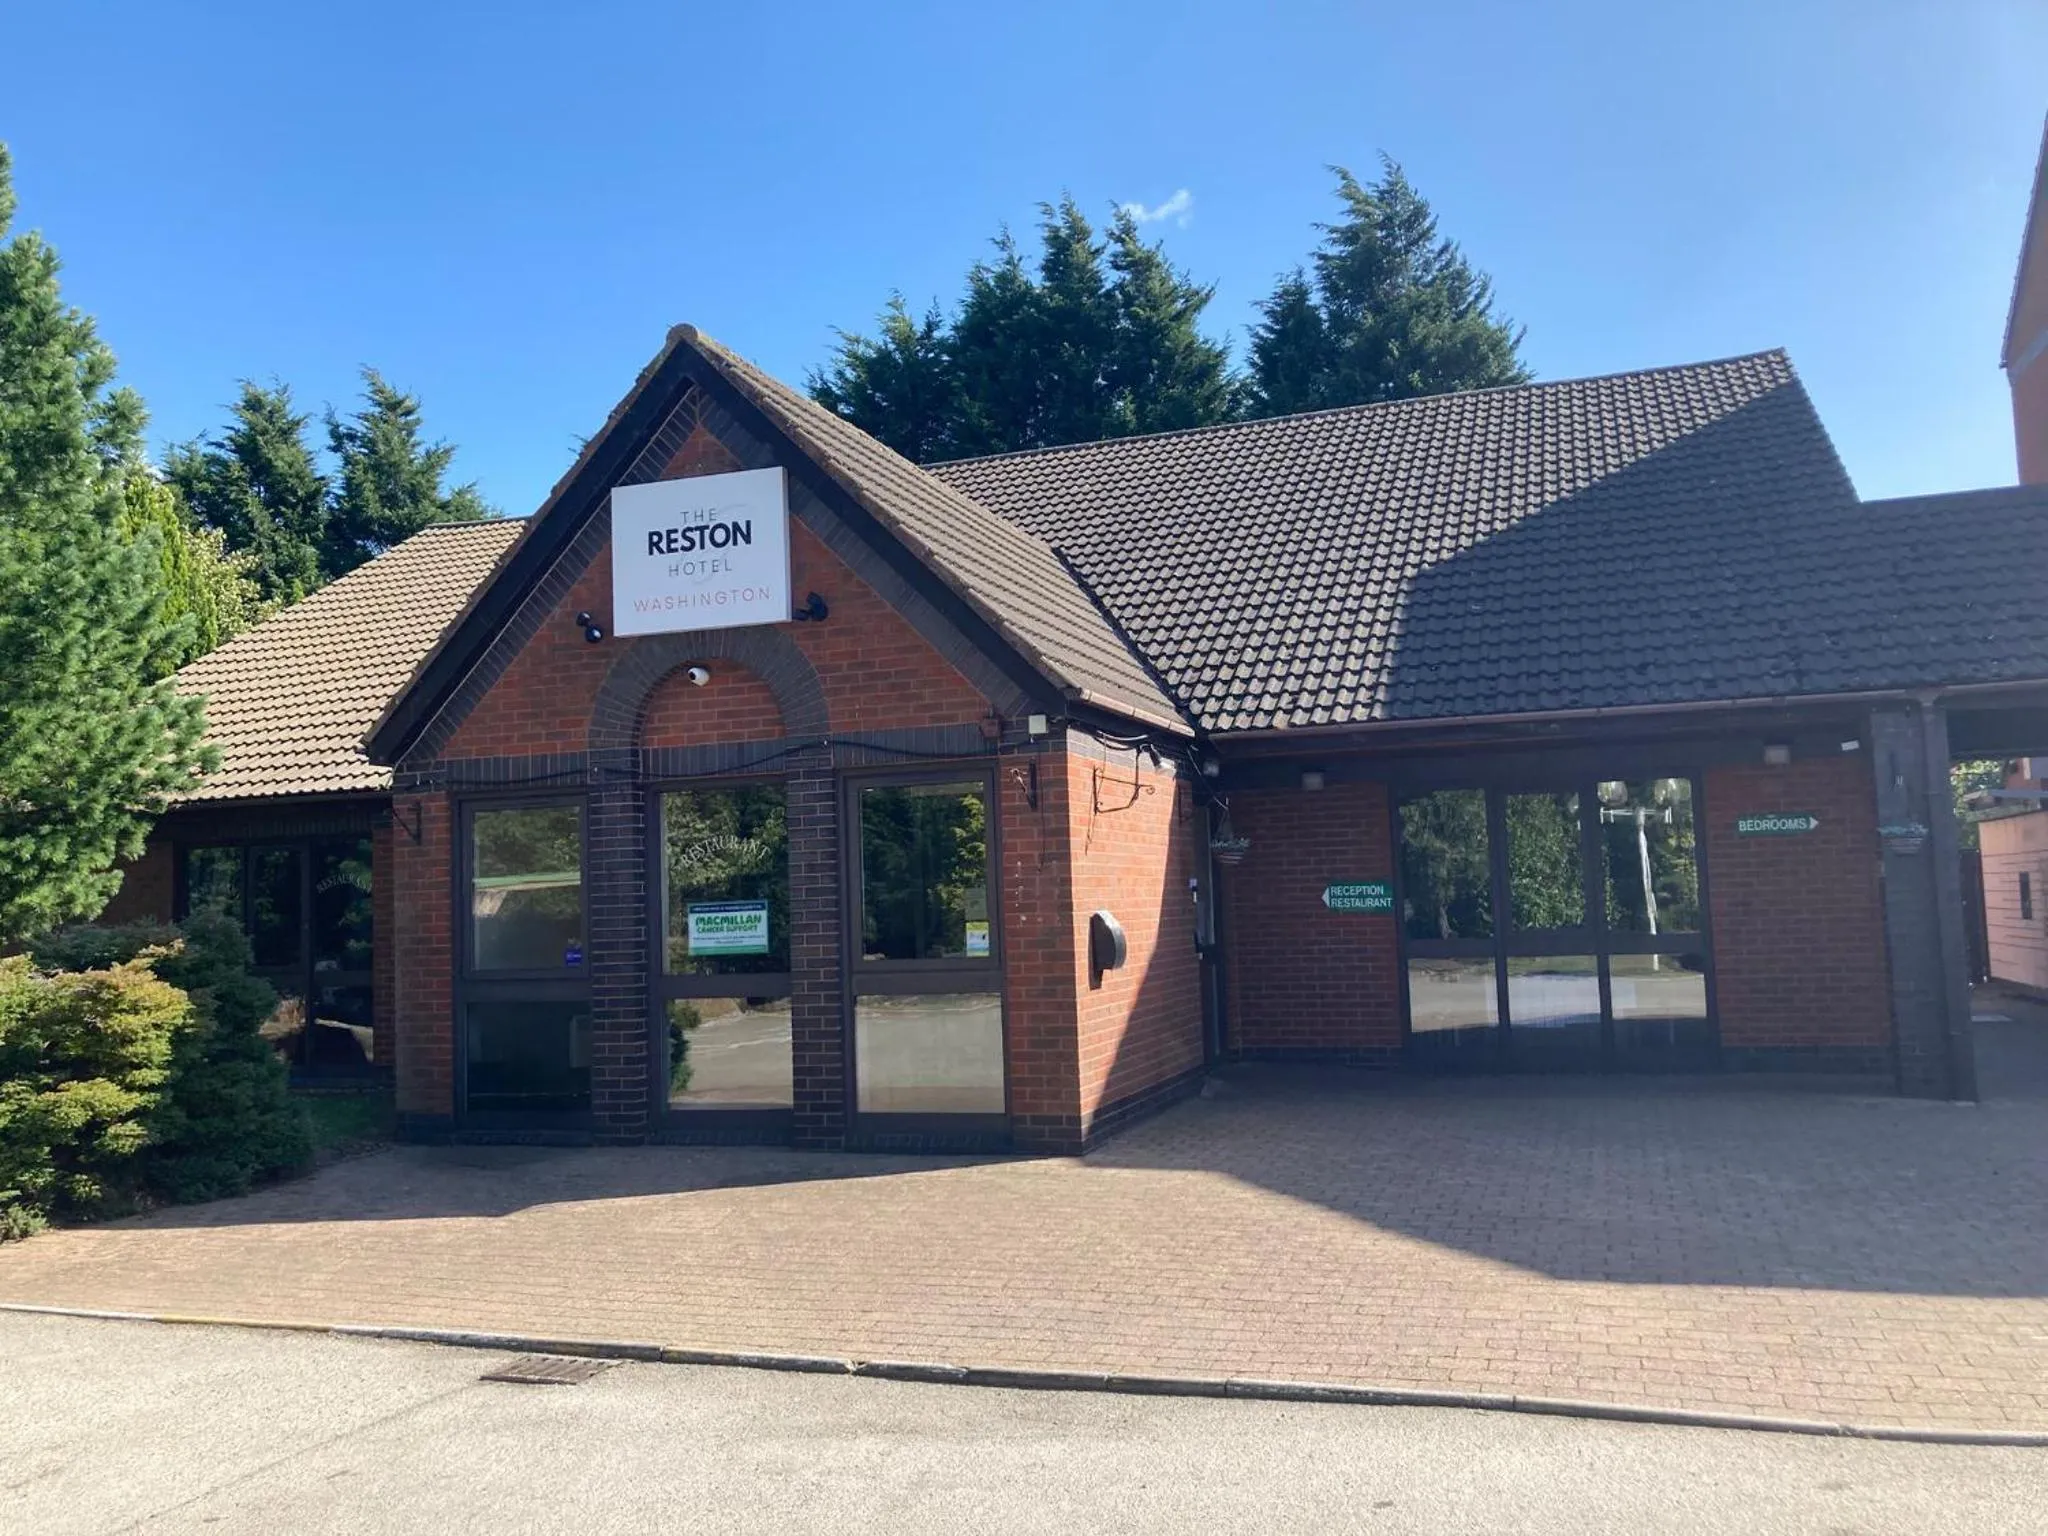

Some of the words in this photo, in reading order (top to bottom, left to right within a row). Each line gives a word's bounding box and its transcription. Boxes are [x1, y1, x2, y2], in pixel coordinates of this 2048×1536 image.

[680, 508, 718, 524] THE
[648, 520, 752, 556] RESTON
[668, 559, 733, 577] HOTEL
[633, 586, 771, 613] WASHINGTON
[1738, 818, 1807, 831] BEDROOMS
[681, 834, 772, 868] RESTAURANT
[1330, 884, 1384, 897] RECEPTION
[1330, 897, 1393, 908] RESTAURANT
[695, 914, 762, 926] MACMILLAN
[726, 924, 758, 933] SUPPORT
